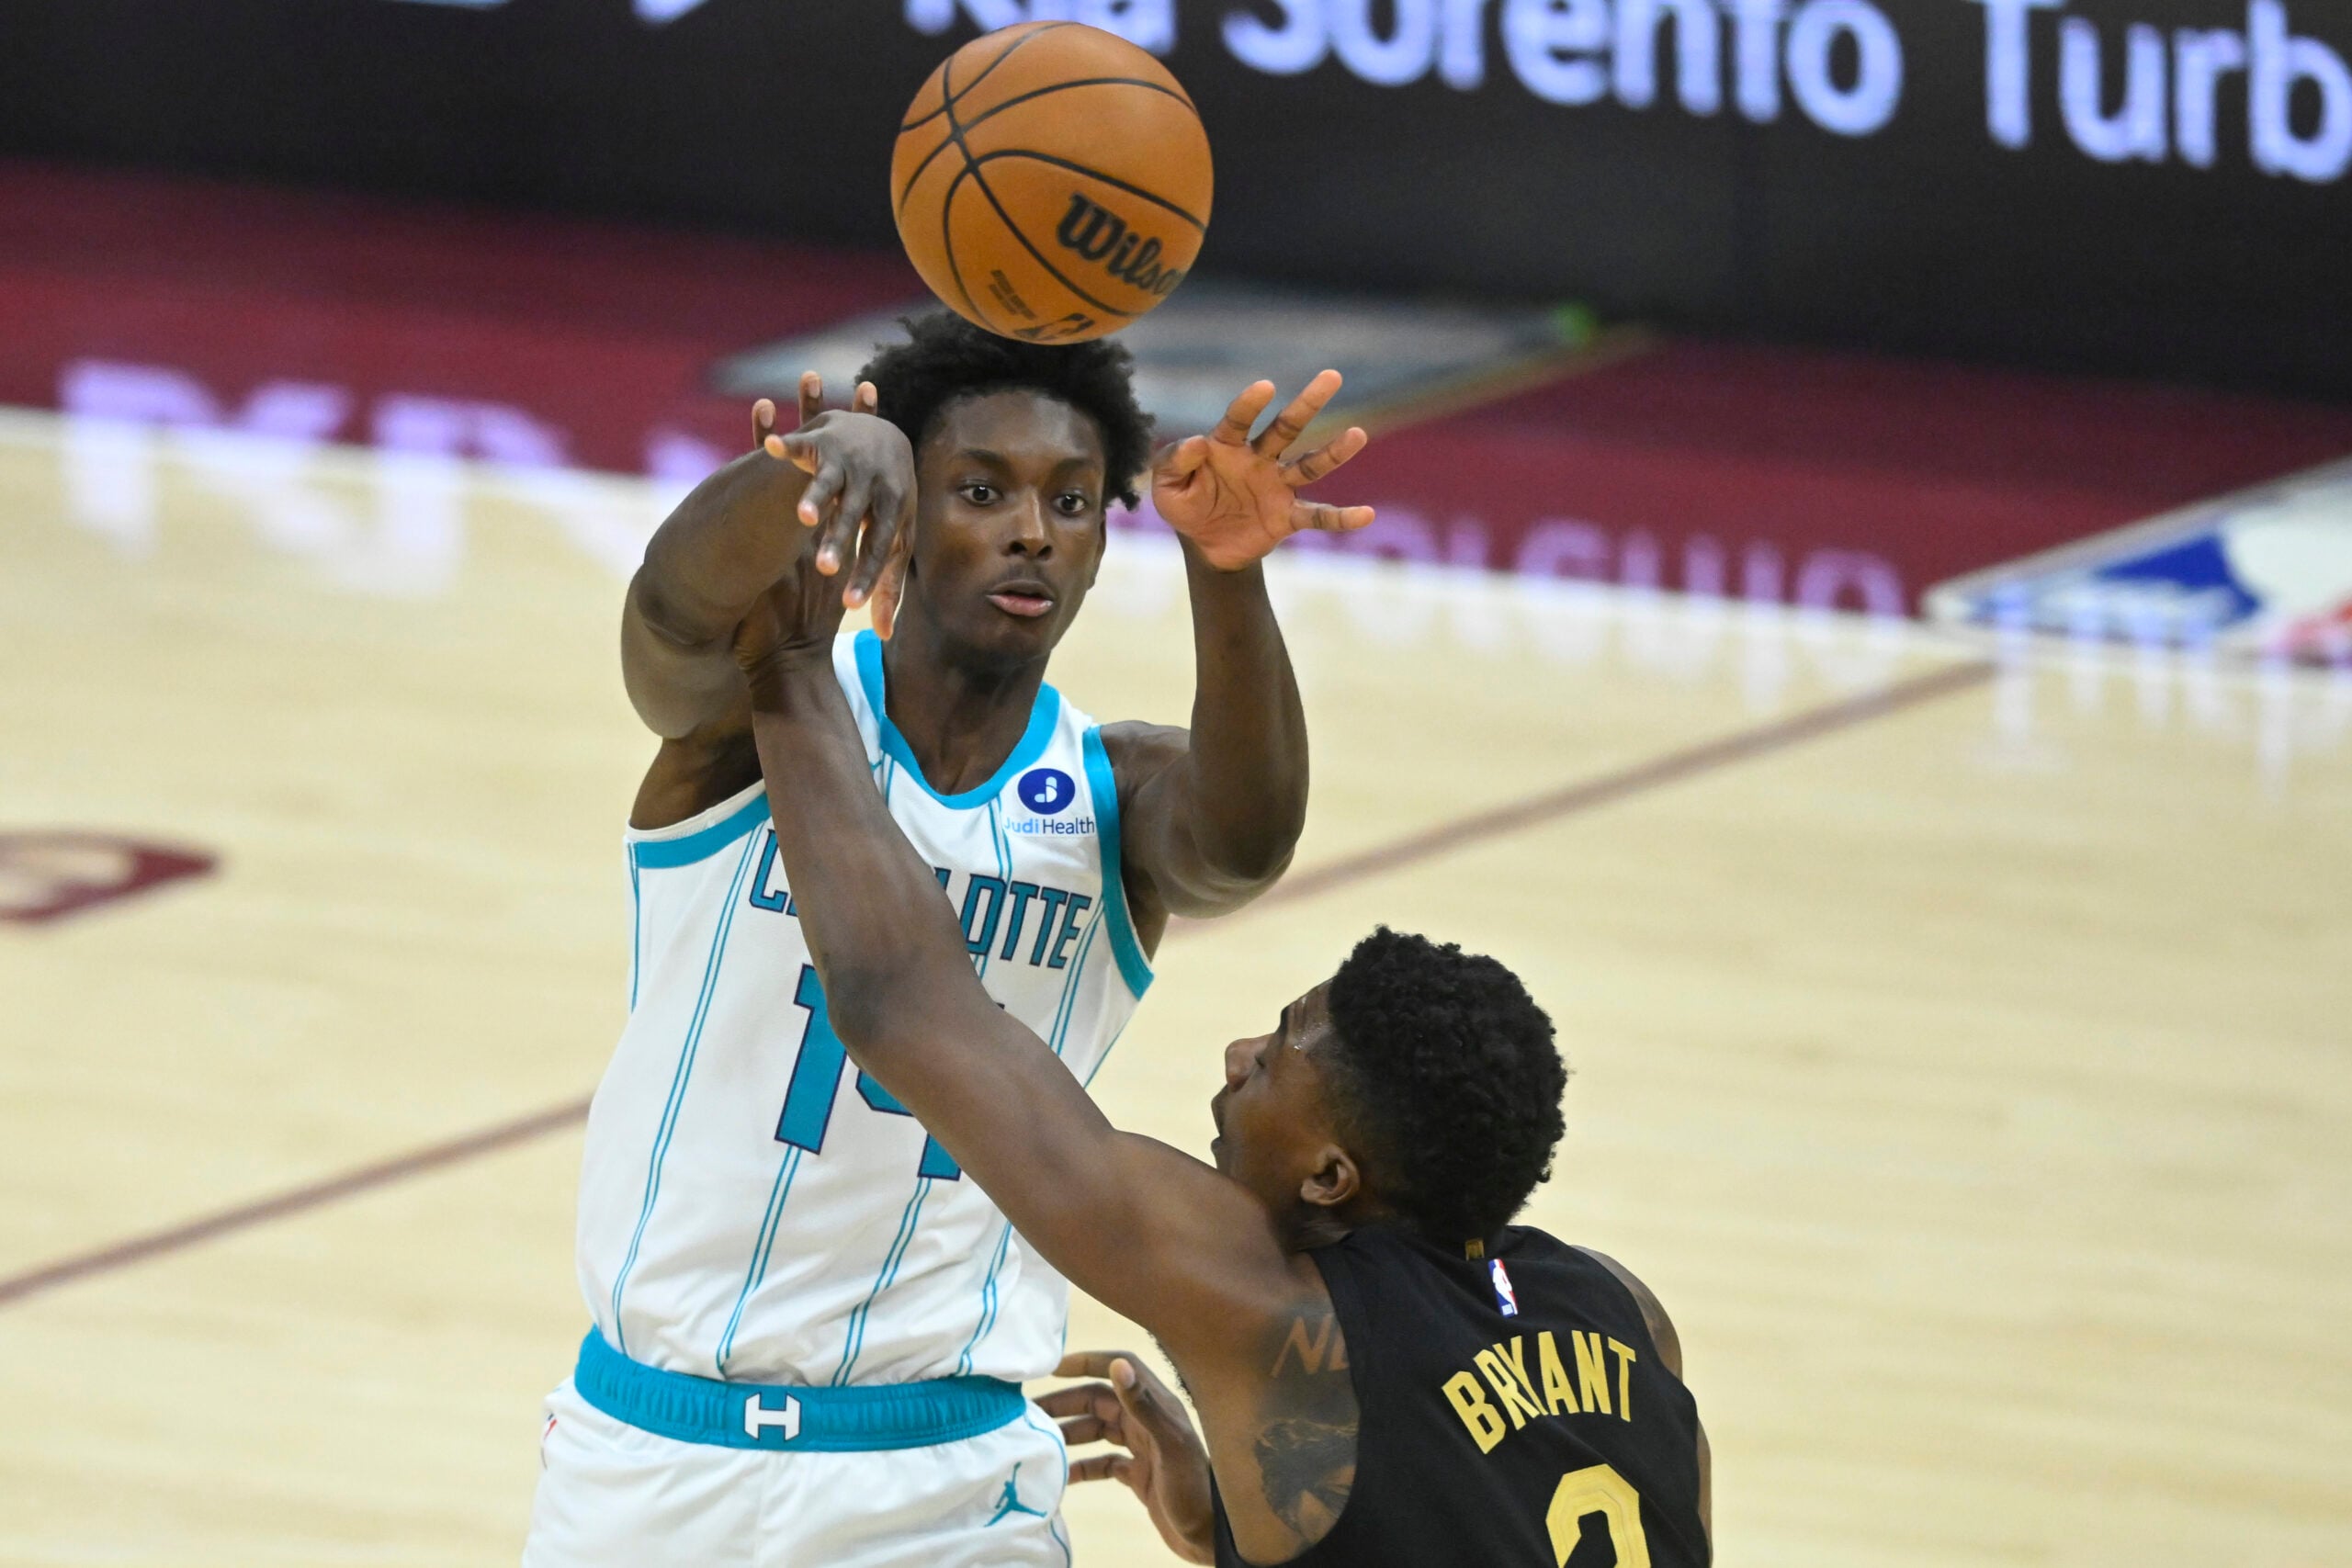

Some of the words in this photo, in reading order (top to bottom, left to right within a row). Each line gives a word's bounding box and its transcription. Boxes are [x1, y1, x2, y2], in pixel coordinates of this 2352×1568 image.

[1042, 817, 1095, 835] Health
[749, 829, 1092, 970] COTTE
[1441, 1329, 1637, 1455] BRYANT
